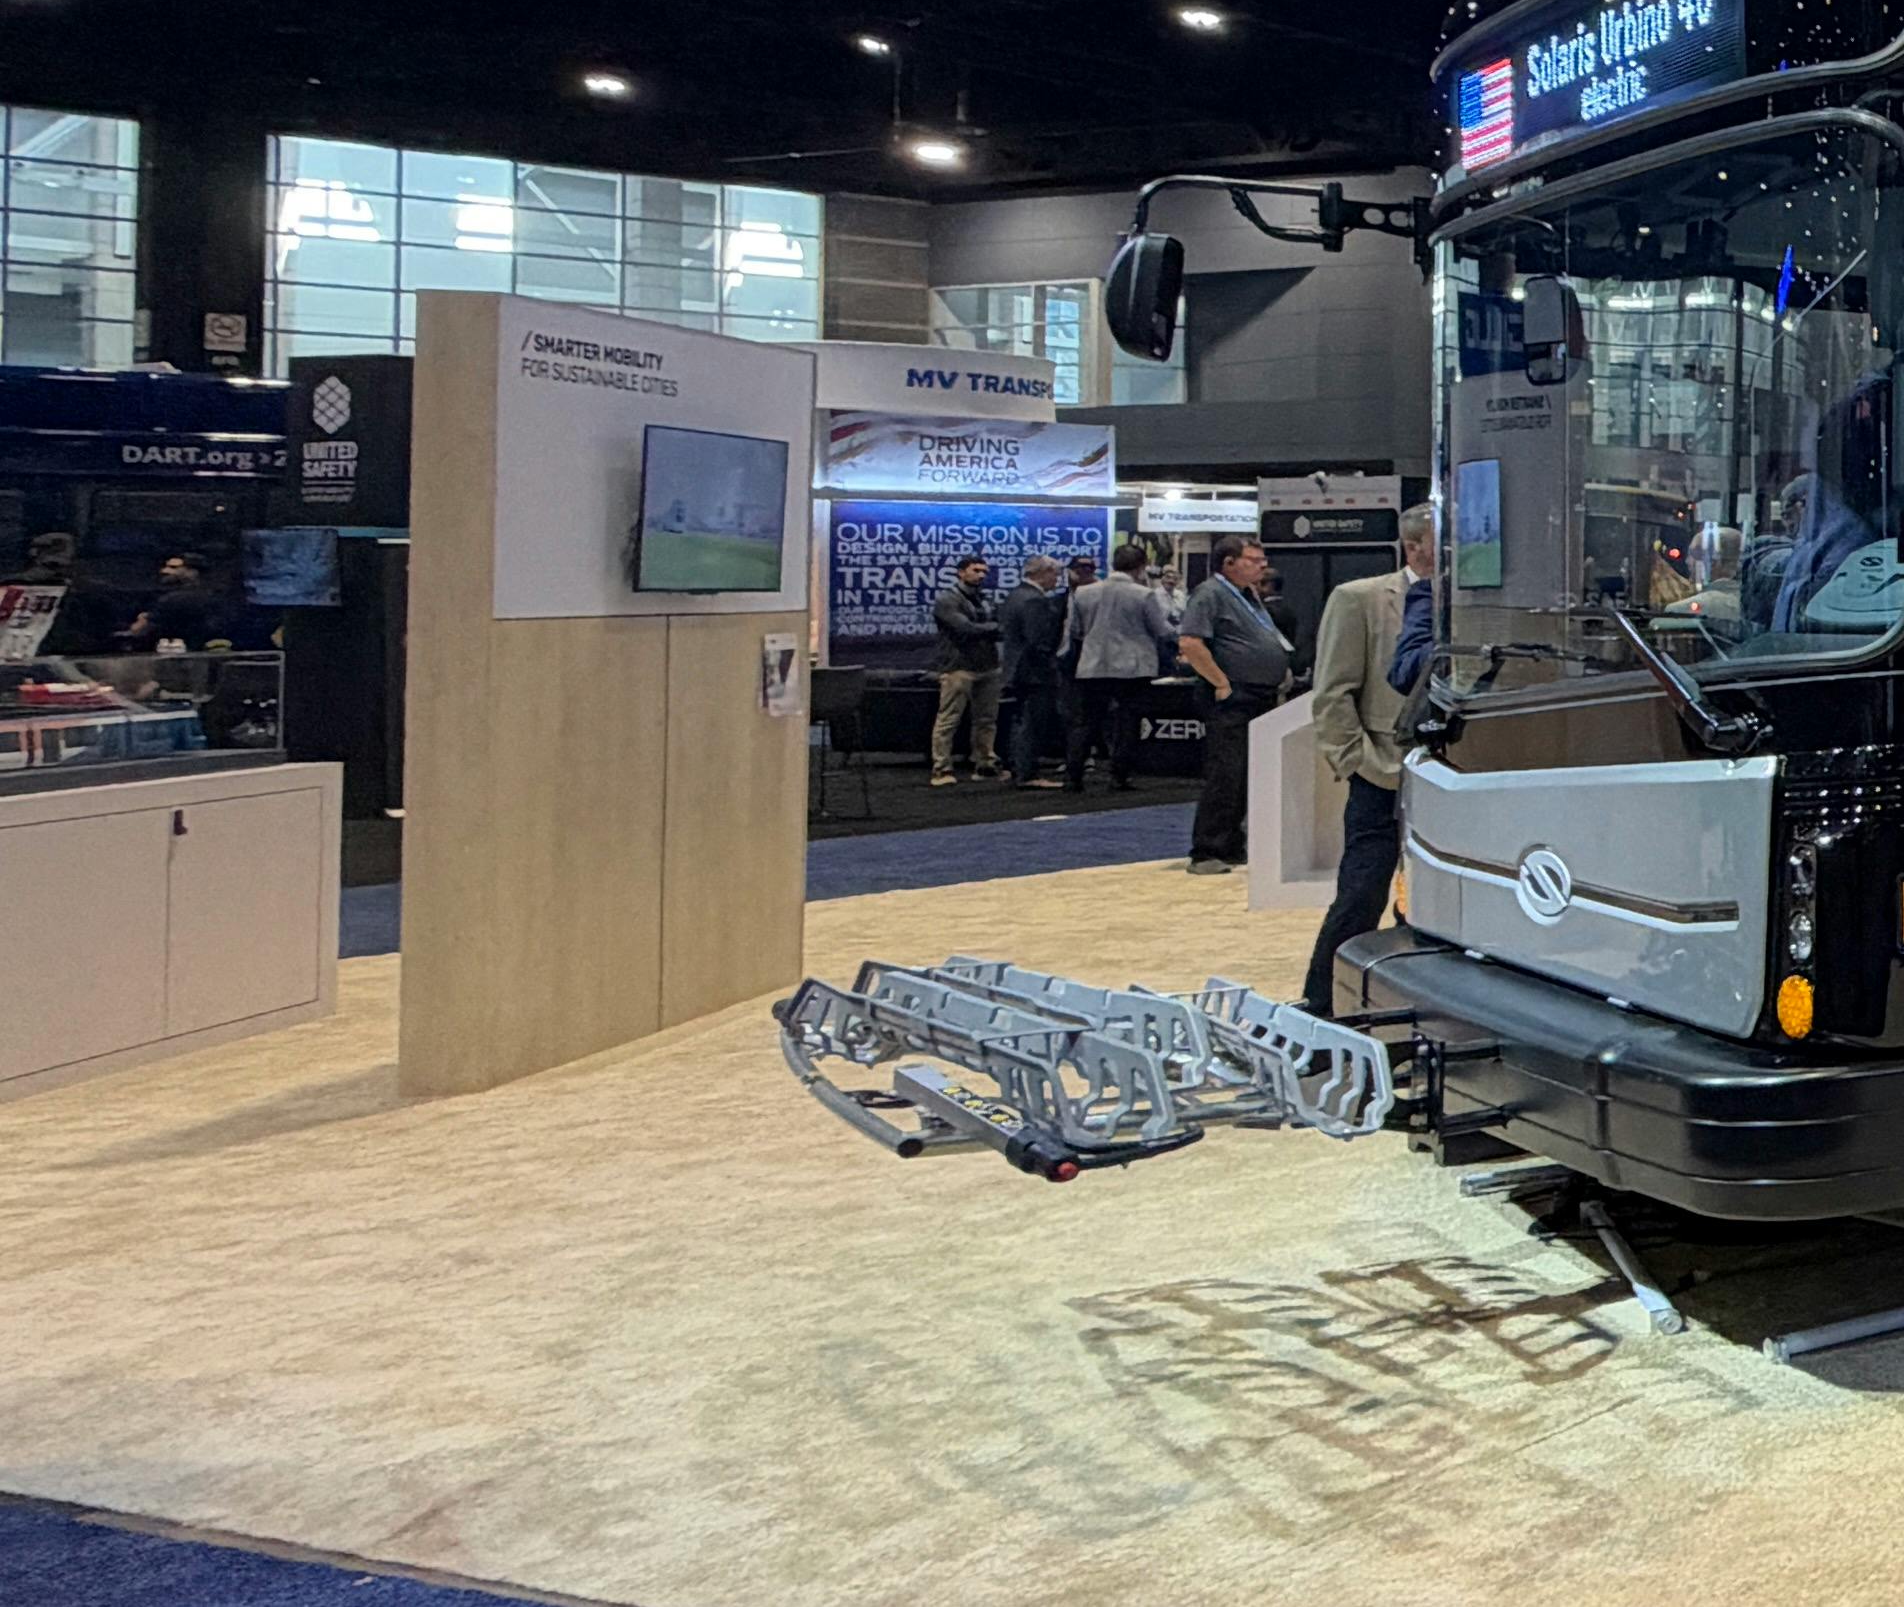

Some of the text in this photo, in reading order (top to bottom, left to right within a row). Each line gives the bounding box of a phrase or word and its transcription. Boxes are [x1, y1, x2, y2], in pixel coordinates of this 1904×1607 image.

[1527, 21, 1597, 98] Solaris
[1580, 59, 1648, 121] electric
[533, 334, 601, 362] SMARTER
[603, 347, 663, 371] MOBILITY
[521, 357, 549, 379] FOR
[551, 361, 639, 392] SUSTAINABLE
[906, 367, 959, 390] MV
[302, 442, 359, 459] UNITED
[918, 434, 1020, 456] DRIVING
[121, 445, 255, 471] DART.org
[302, 460, 357, 477] SAFETY
[919, 453, 1018, 471] AMERICA
[917, 467, 1020, 486] FORWARD
[837, 523, 1103, 545] OUR MISSION IS TO
[837, 555, 871, 566] THE
[876, 555, 941, 567] SAFEST
[981, 544, 1019, 555] AND
[1022, 545, 1102, 557] SUPPORT
[836, 566, 960, 589] TRANS
[836, 589, 862, 605] IN
[867, 589, 918, 605] THE
